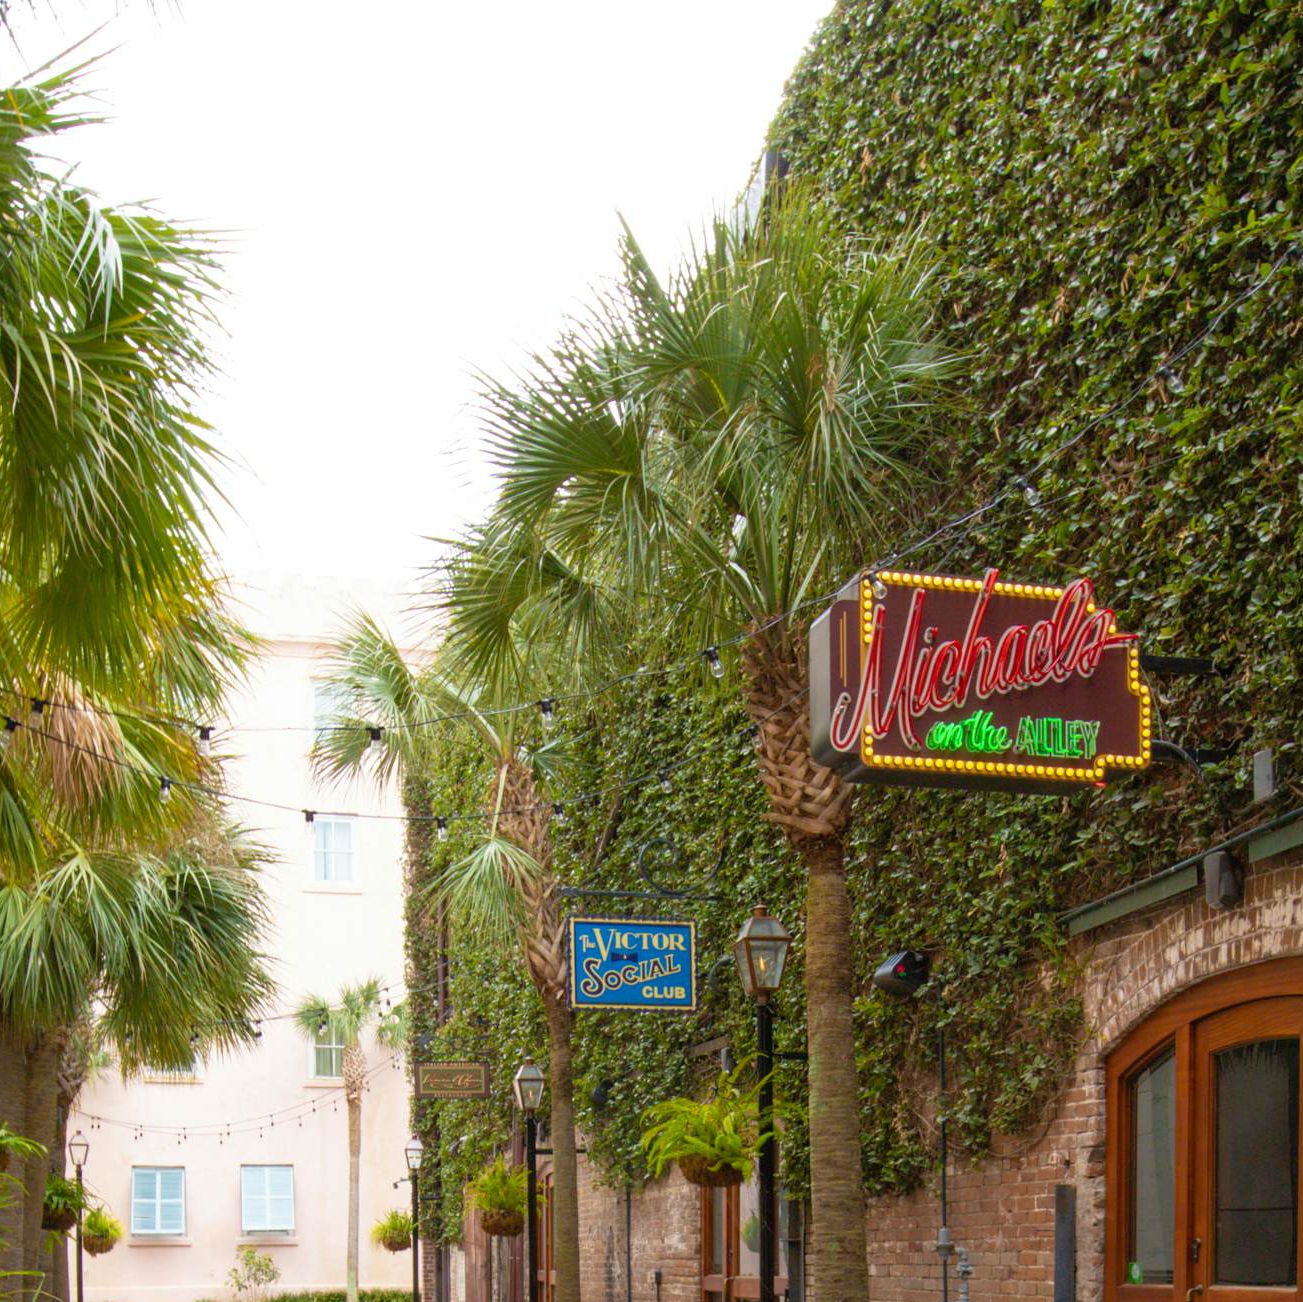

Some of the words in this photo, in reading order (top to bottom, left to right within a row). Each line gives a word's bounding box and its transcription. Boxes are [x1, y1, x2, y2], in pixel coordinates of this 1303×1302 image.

[926, 721, 963, 750] on
[961, 709, 1013, 753] the
[1014, 715, 1100, 759] ALLEY
[579, 935, 596, 952] The
[593, 928, 686, 961] VICTOR
[581, 954, 681, 997] SOCIAL
[642, 985, 686, 998] CLUB
